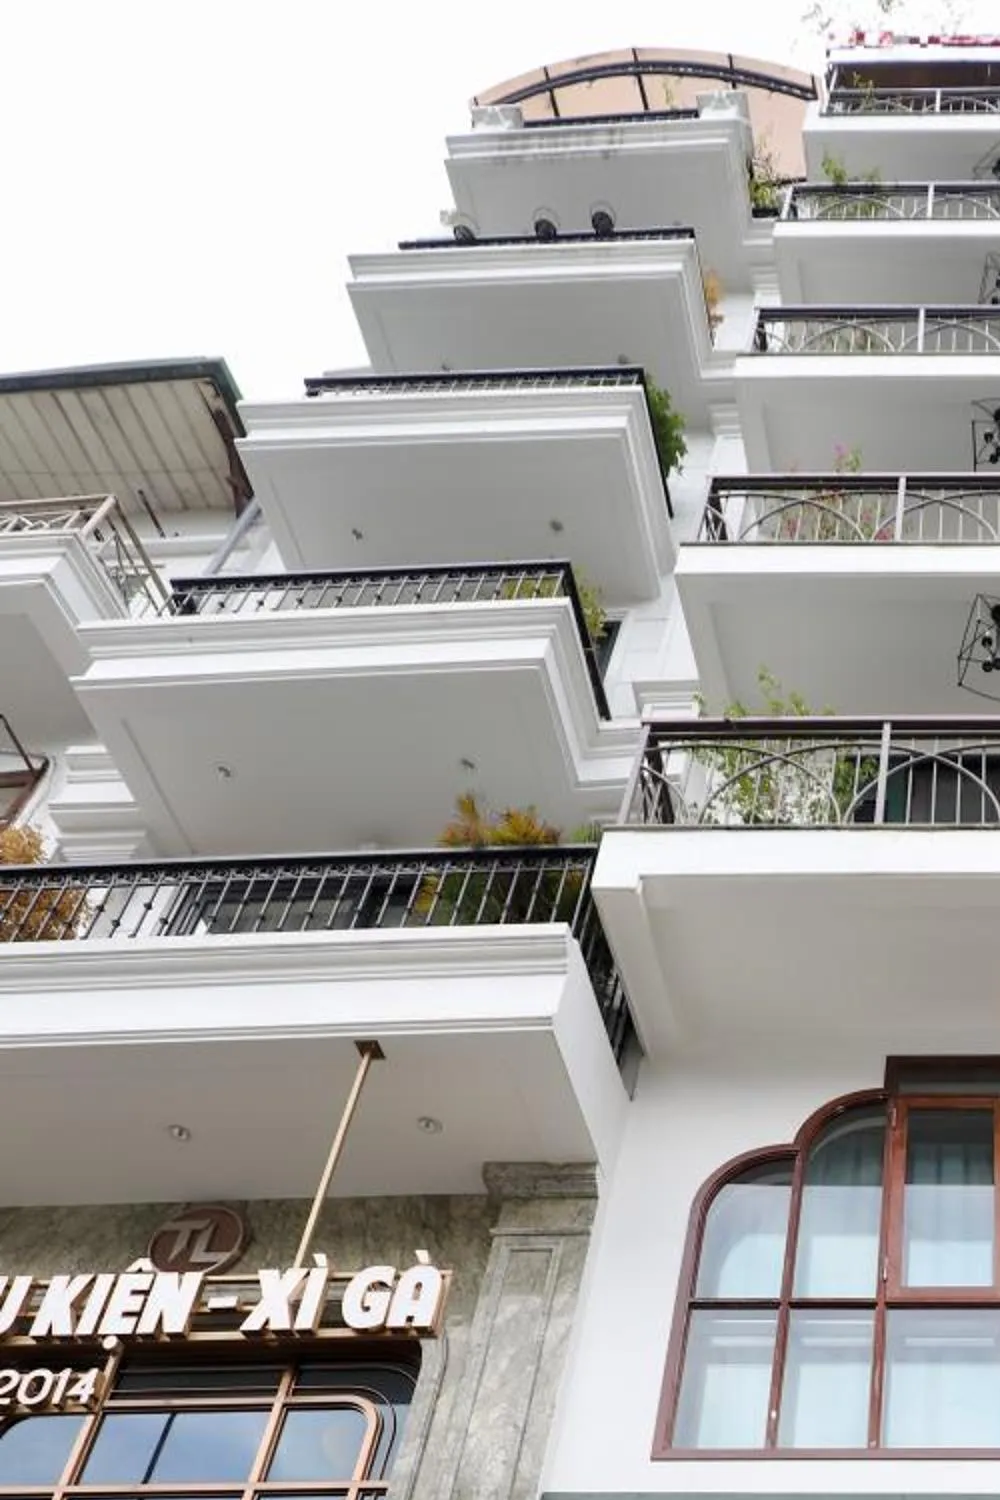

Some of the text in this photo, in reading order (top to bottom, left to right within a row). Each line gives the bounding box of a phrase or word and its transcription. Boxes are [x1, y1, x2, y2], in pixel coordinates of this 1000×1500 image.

[28, 1258, 204, 1349] KIỆN
[240, 1253, 331, 1336] XÌ
[341, 1250, 445, 1331] GÀ
[0, 1368, 100, 1405] 2014
